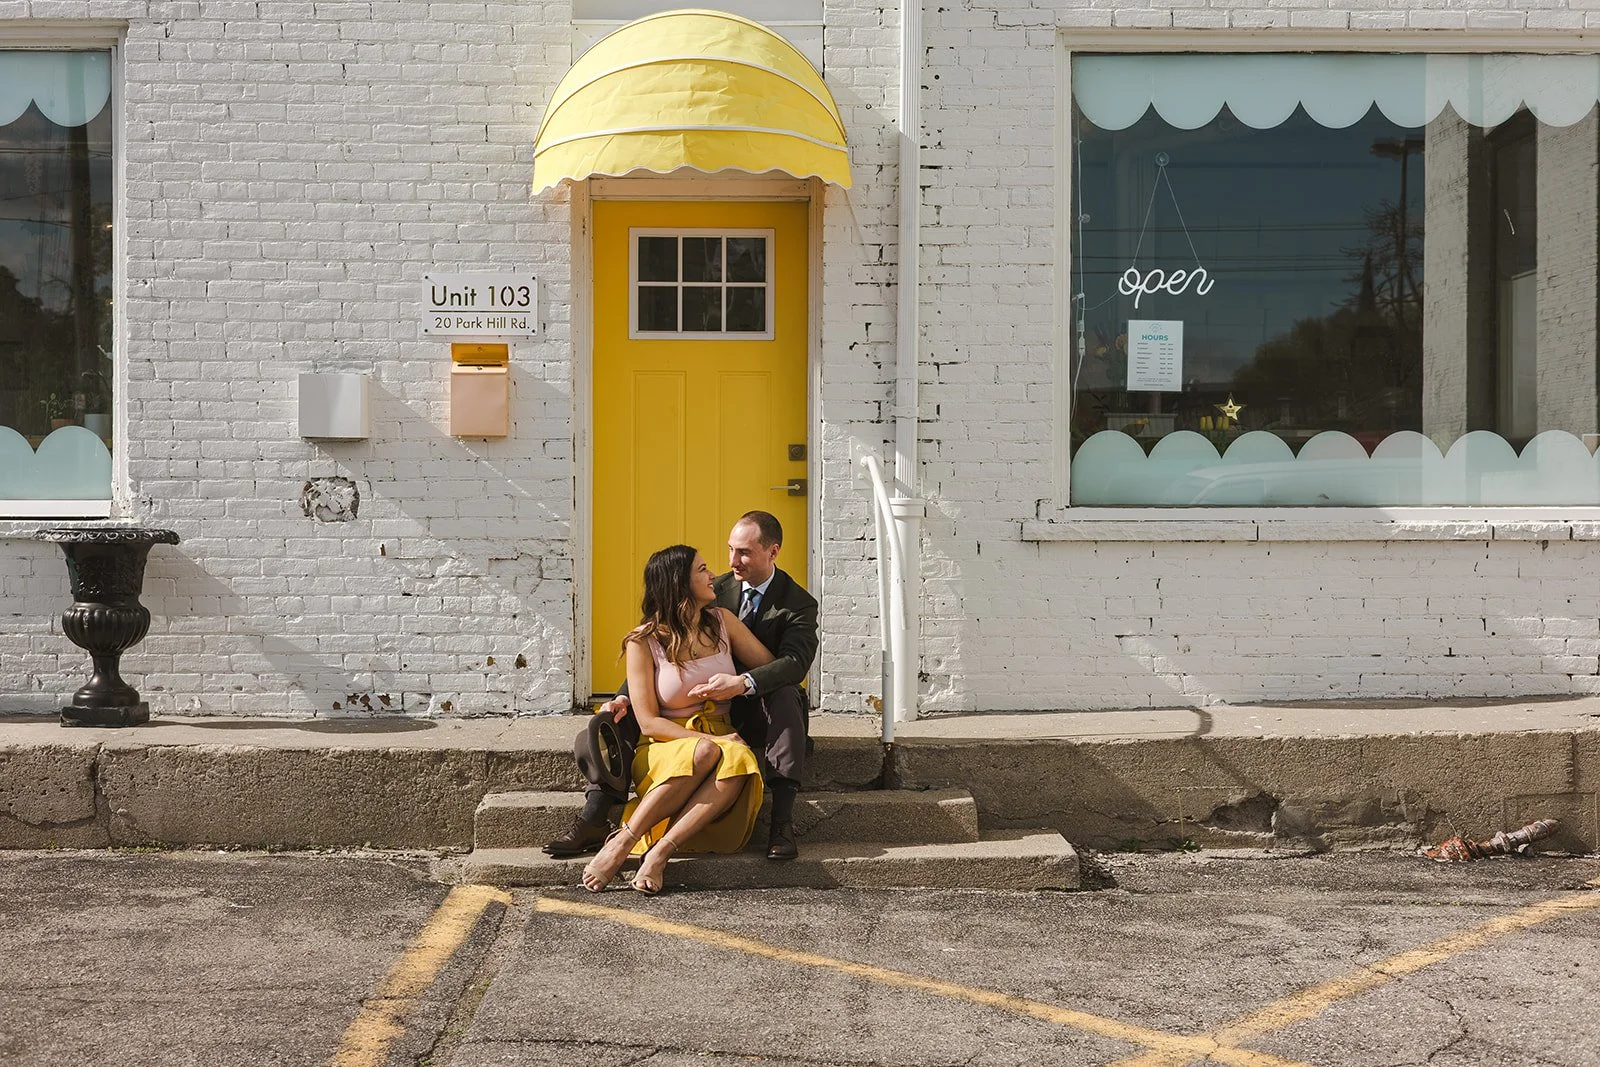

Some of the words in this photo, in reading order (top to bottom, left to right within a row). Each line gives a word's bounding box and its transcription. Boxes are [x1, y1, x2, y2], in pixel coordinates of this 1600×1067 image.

[431, 285, 477, 306] Unit
[488, 285, 530, 306] 103
[1118, 268, 1215, 309] open
[434, 317, 451, 329] 20
[456, 316, 482, 329] Park
[487, 316, 506, 329] Hill
[511, 316, 530, 329] Rd.
